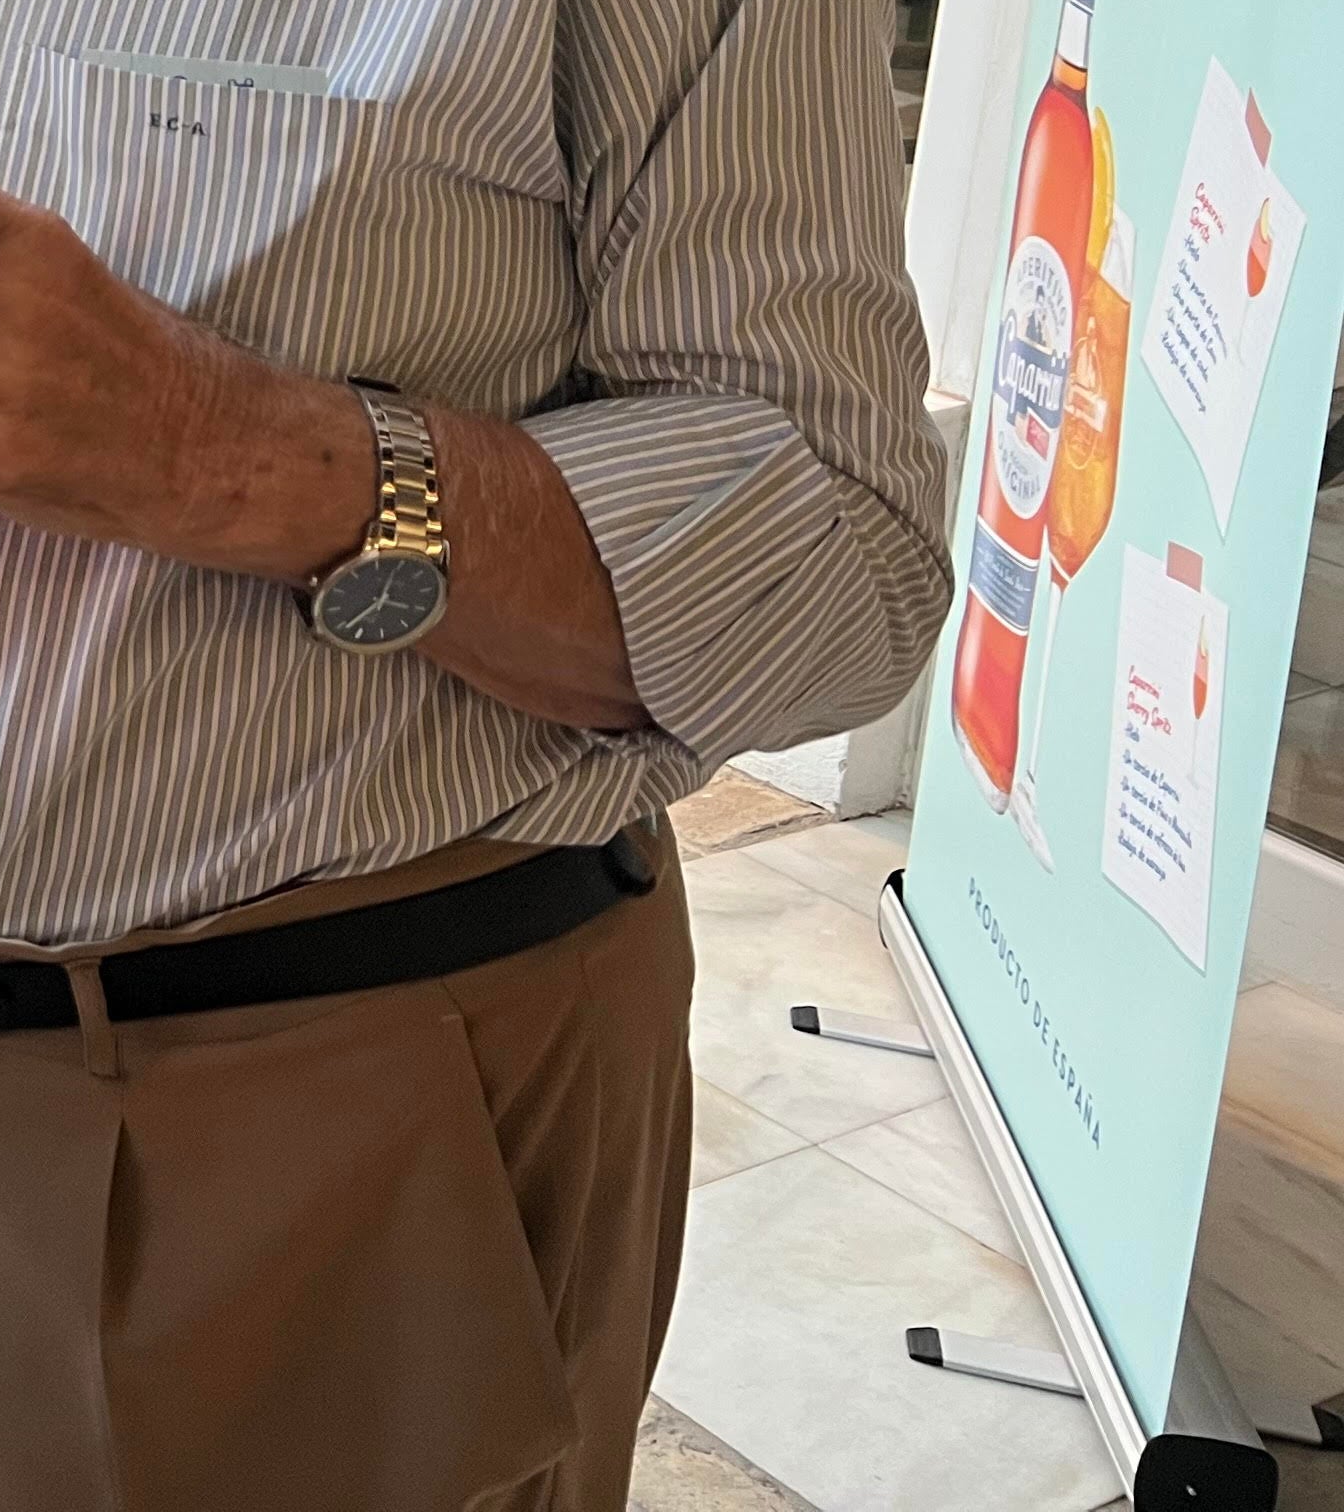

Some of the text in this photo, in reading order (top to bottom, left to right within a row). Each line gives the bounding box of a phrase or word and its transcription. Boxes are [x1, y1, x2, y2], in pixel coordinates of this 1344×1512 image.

[969, 876, 1101, 1151] PRODUCTO DE ESPAÑA
